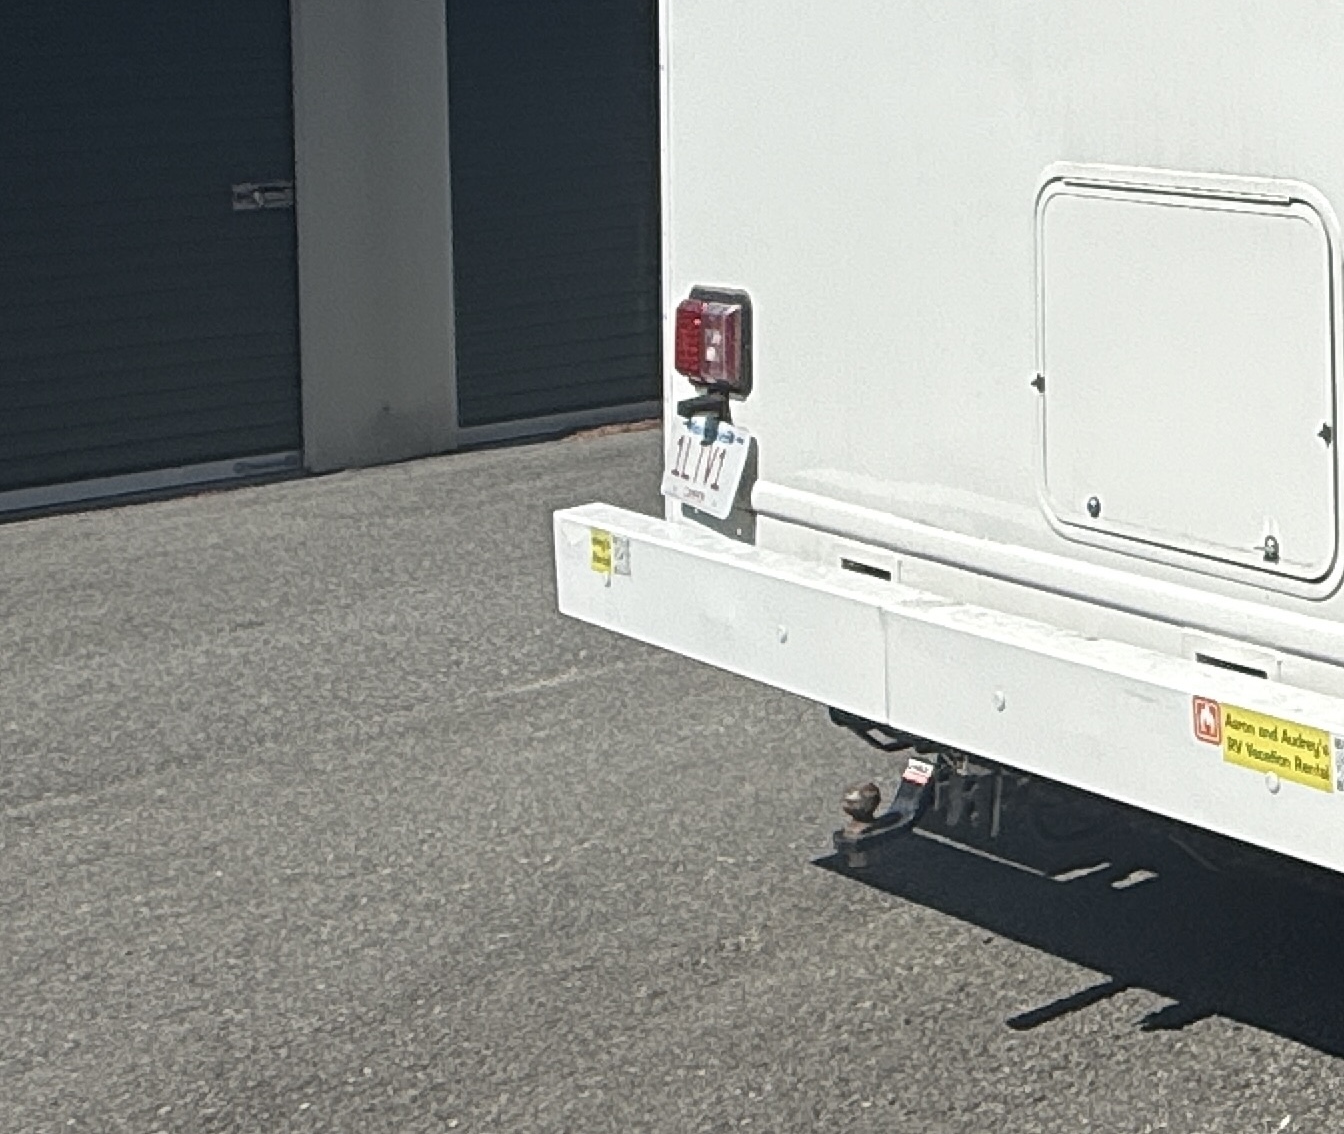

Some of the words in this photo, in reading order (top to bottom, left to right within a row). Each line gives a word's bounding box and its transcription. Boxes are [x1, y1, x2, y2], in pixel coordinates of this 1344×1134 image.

[1225, 713, 1255, 735] Aaron
[1259, 726, 1278, 742] and
[1281, 729, 1329, 759] Audrey's
[1227, 736, 1243, 754] RV
[1245, 742, 1291, 769] Vacation
[1294, 755, 1330, 781] Rental
